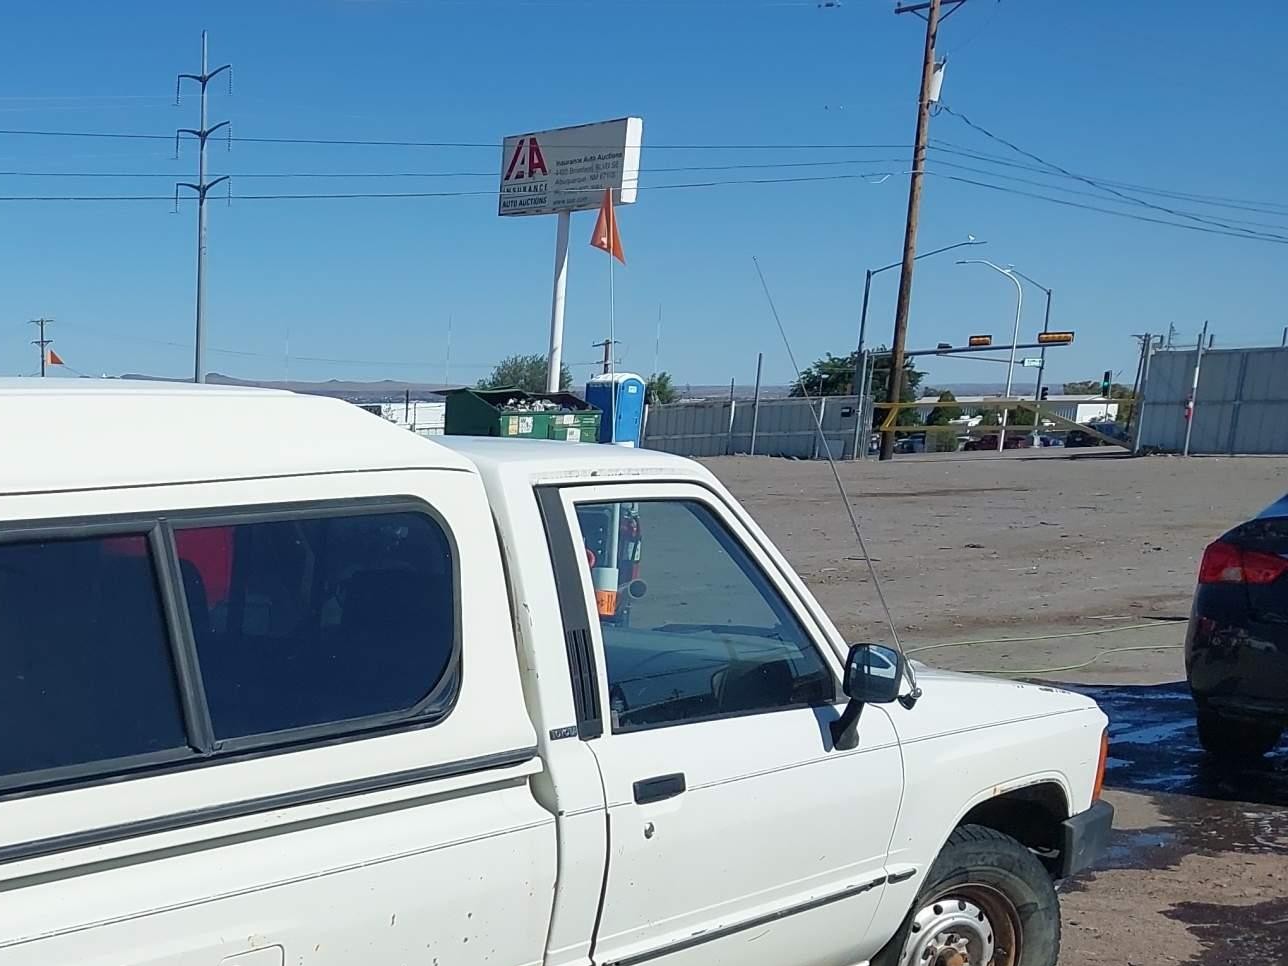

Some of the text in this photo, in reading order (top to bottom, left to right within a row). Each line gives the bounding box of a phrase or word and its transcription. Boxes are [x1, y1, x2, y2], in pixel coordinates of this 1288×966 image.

[503, 183, 548, 193] INSURANCE
[502, 199, 518, 208] AUTO
[518, 196, 548, 207] AUCTIONS
